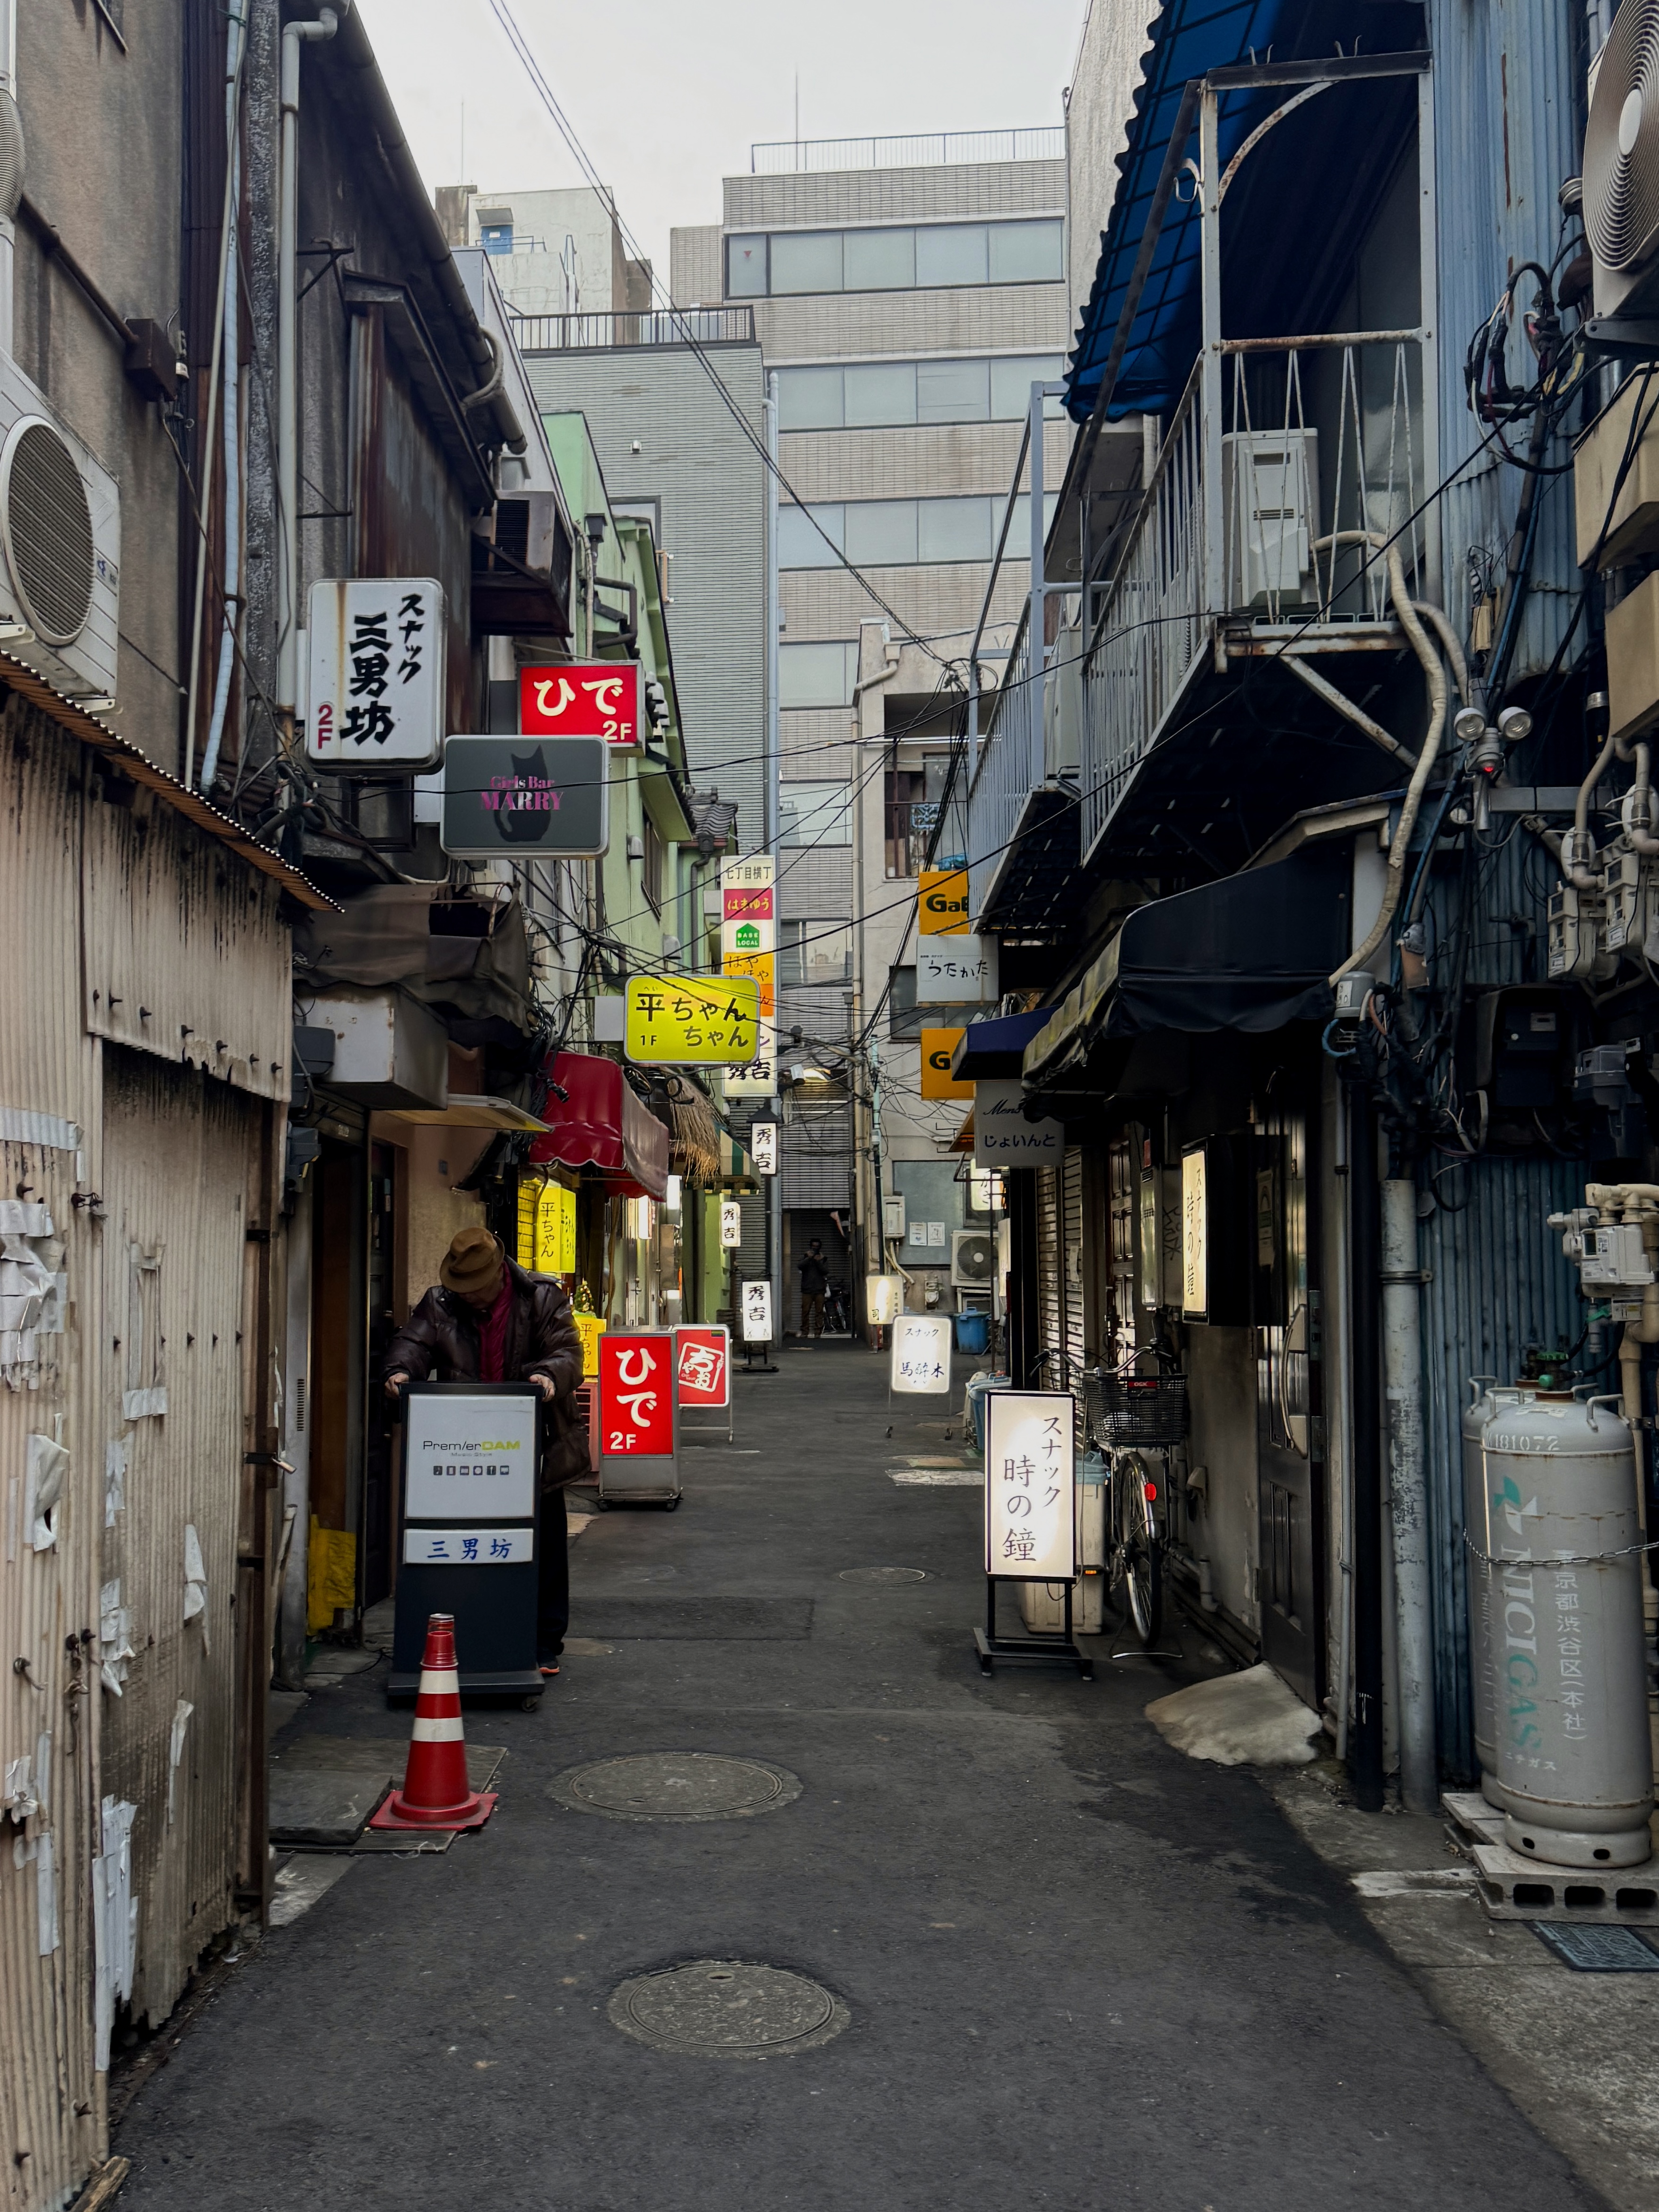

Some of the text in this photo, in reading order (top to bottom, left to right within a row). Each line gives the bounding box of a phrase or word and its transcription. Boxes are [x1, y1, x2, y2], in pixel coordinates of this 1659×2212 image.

[398, 593, 425, 684] スナック
[339, 612, 396, 745] 三男坊
[533, 677, 624, 717] ひで
[318, 704, 332, 749] 2F
[603, 720, 632, 740] 2F
[490, 775, 555, 789] Girls Bar
[480, 791, 564, 810] MARRY
[726, 867, 772, 879] 七丁目横丁
[929, 960, 988, 978] うたかた
[636, 993, 747, 1022] 平ちゃん
[640, 1035, 657, 1046] 1F
[684, 1026, 749, 1047] ちゃん
[756, 1128, 772, 1169] 秀吉
[985, 1134, 1055, 1147] じょいんと
[540, 1202, 555, 1257] 平ちゃん
[724, 1208, 735, 1239] 秀吉
[748, 1285, 765, 1321] 秀吉
[905, 1328, 939, 1337] スナック
[616, 1347, 657, 1428] ひで
[610, 1431, 636, 1450] 2F
[1042, 1417, 1062, 1508] スナック
[1003, 1455, 1036, 1561] 時の鐘
[427, 1538, 512, 1560] 三男坊
